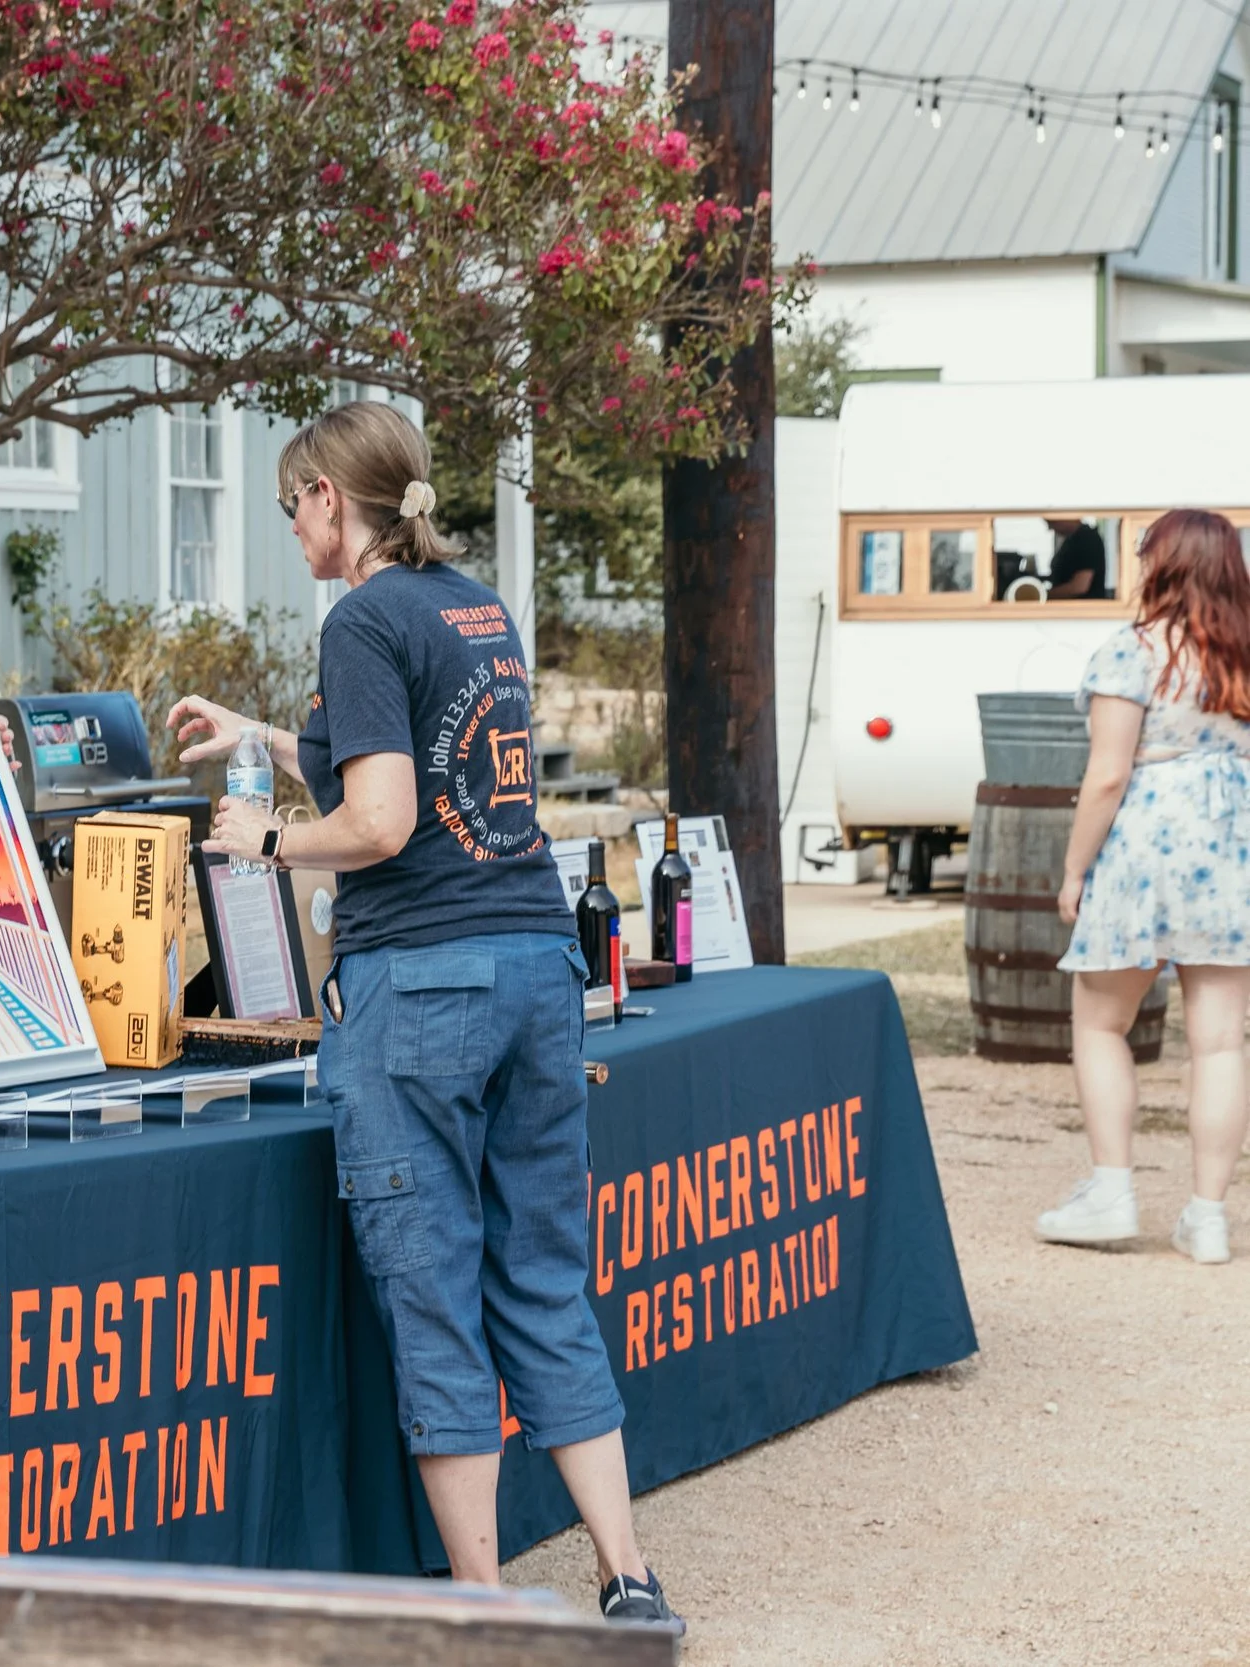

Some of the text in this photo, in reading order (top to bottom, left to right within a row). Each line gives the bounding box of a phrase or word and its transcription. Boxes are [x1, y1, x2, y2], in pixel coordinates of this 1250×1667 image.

[440, 604, 506, 626] CORNERSTONE
[477, 692, 494, 718] 4:10
[493, 686, 511, 702] Use
[428, 728, 454, 776] John
[441, 662, 491, 730] 13:34-35
[493, 656, 510, 678] As
[459, 714, 479, 750] Peter
[457, 751, 469, 761] 1
[500, 747, 527, 786] CR
[455, 768, 475, 810] Grace.
[487, 830, 501, 845] of
[595, 1095, 867, 1297] CORNERSTONE
[625, 1214, 840, 1373] RESTORATION
